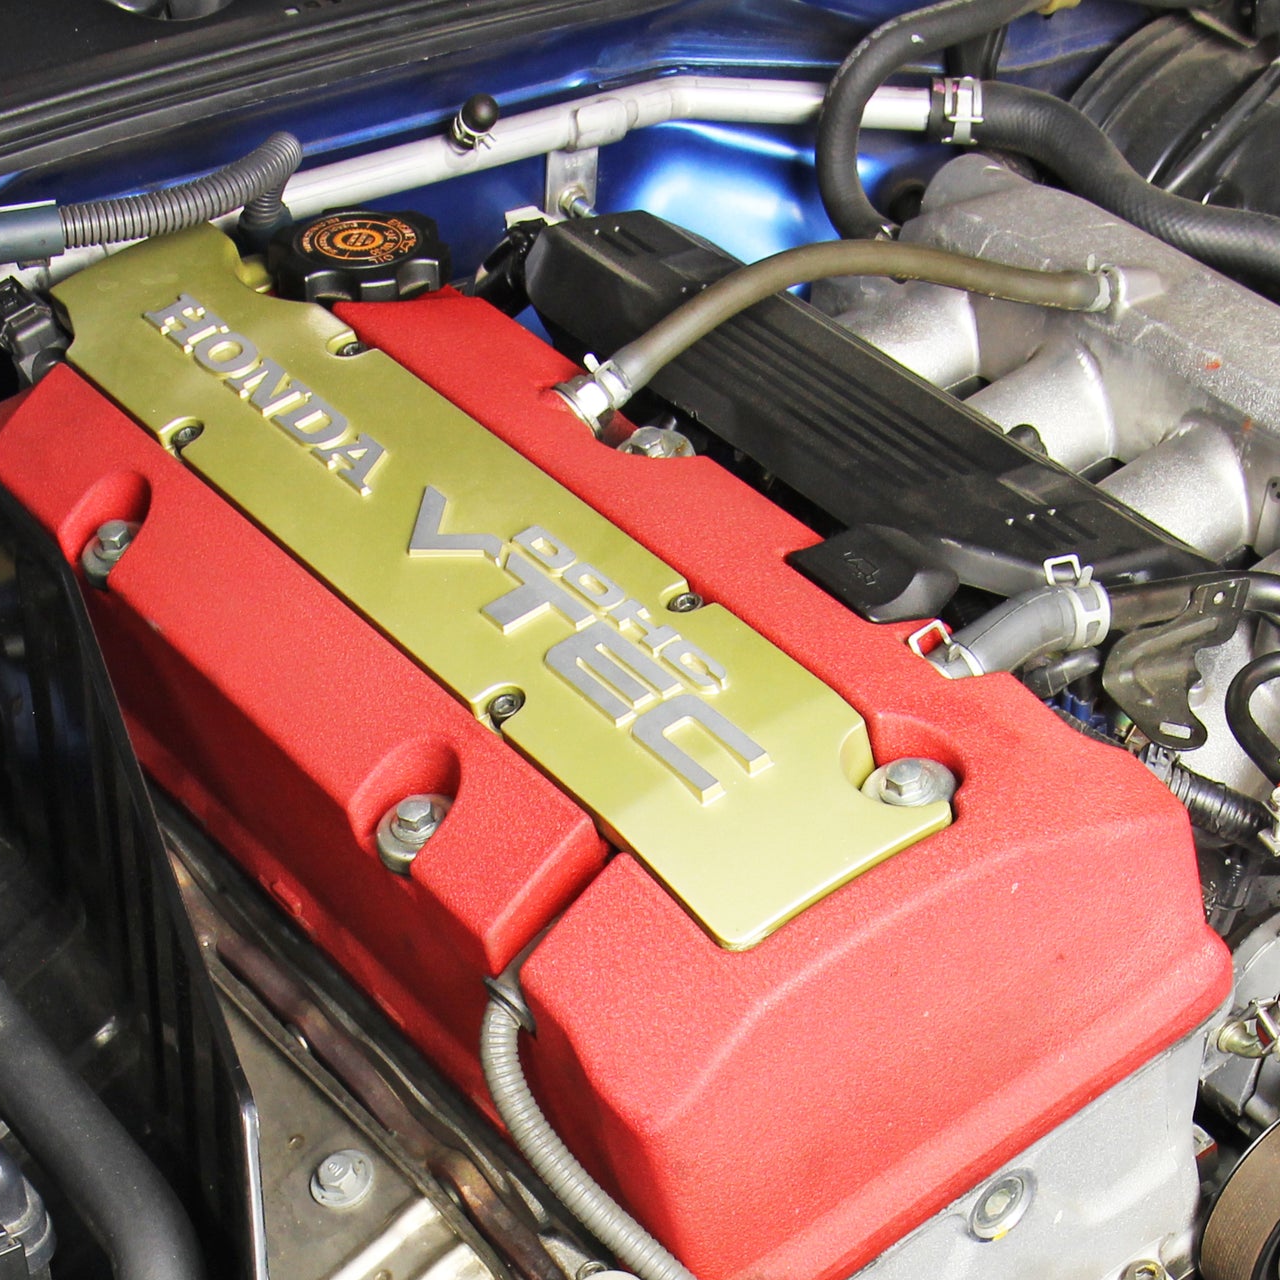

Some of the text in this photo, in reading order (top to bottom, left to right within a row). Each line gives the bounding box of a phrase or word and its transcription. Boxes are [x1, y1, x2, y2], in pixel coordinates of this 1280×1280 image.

[141, 292, 391, 496] HONDA
[407, 483, 776, 805] VTEC
[508, 526, 729, 696] DOHC
